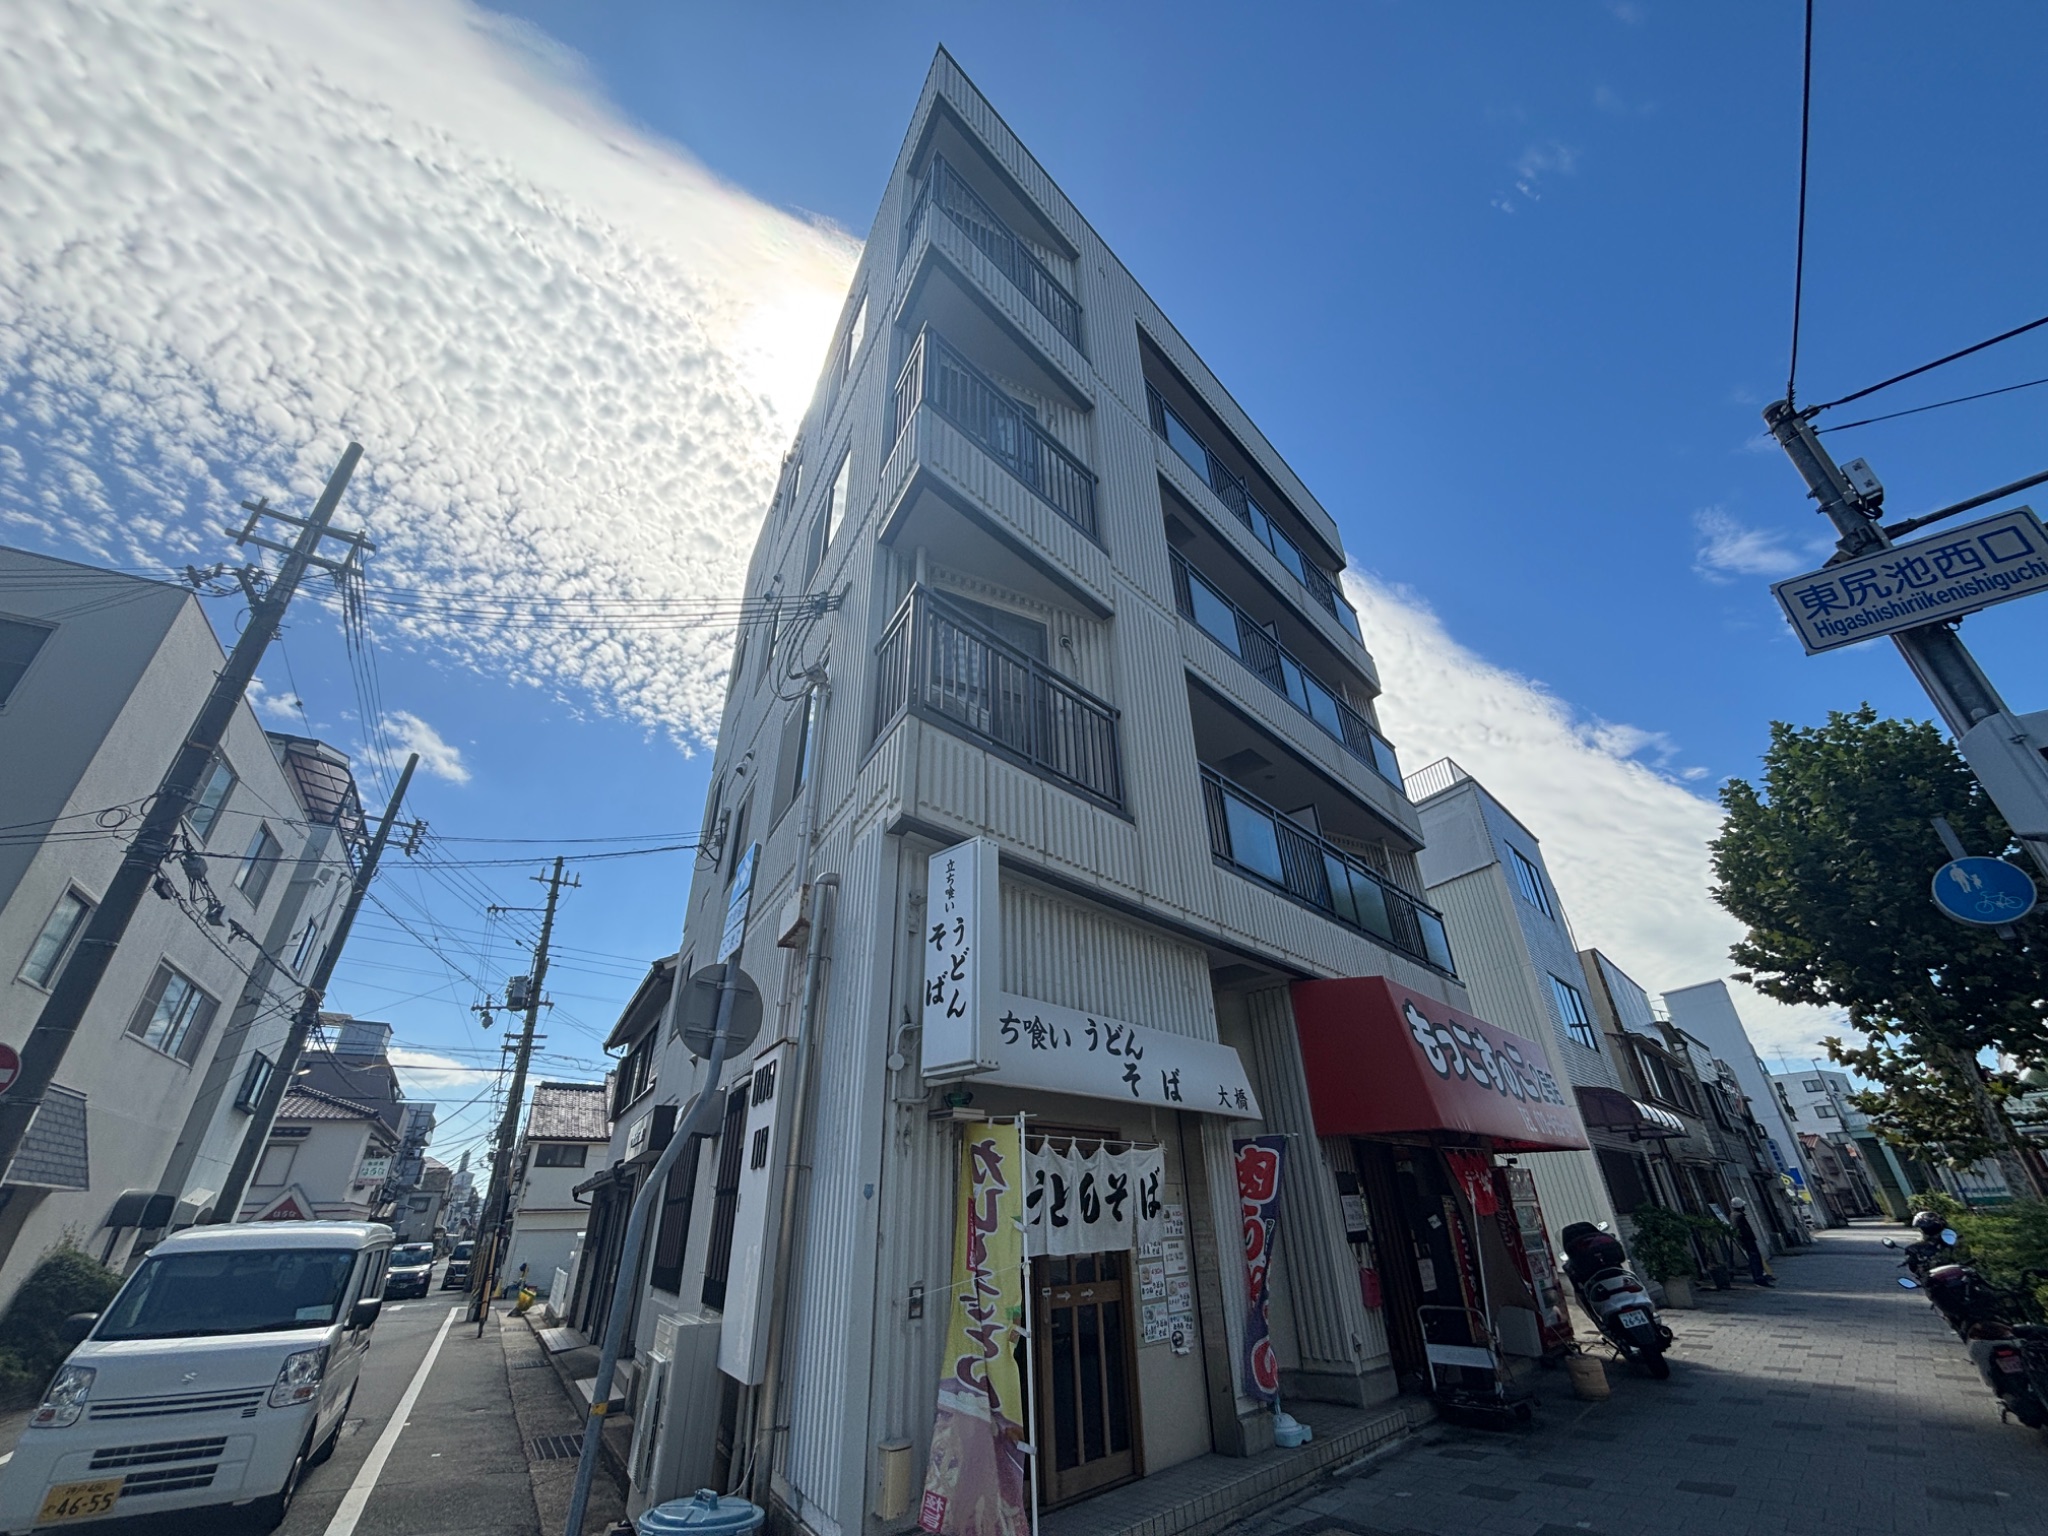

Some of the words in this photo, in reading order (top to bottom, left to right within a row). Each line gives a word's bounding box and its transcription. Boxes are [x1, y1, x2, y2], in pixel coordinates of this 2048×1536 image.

[1793, 525, 2035, 620] 東尻池西口
[1812, 557, 2048, 638] Higashishiriikenishiguchi
[944, 859, 956, 913] 立ち喰い
[925, 922, 949, 1007] そば
[946, 917, 970, 1019] うどん
[1084, 1018, 1145, 1061] うどん
[1121, 1063, 1183, 1103] そば
[1218, 1084, 1250, 1112] 大橋
[56, 1492, 114, 1516] 46-55
